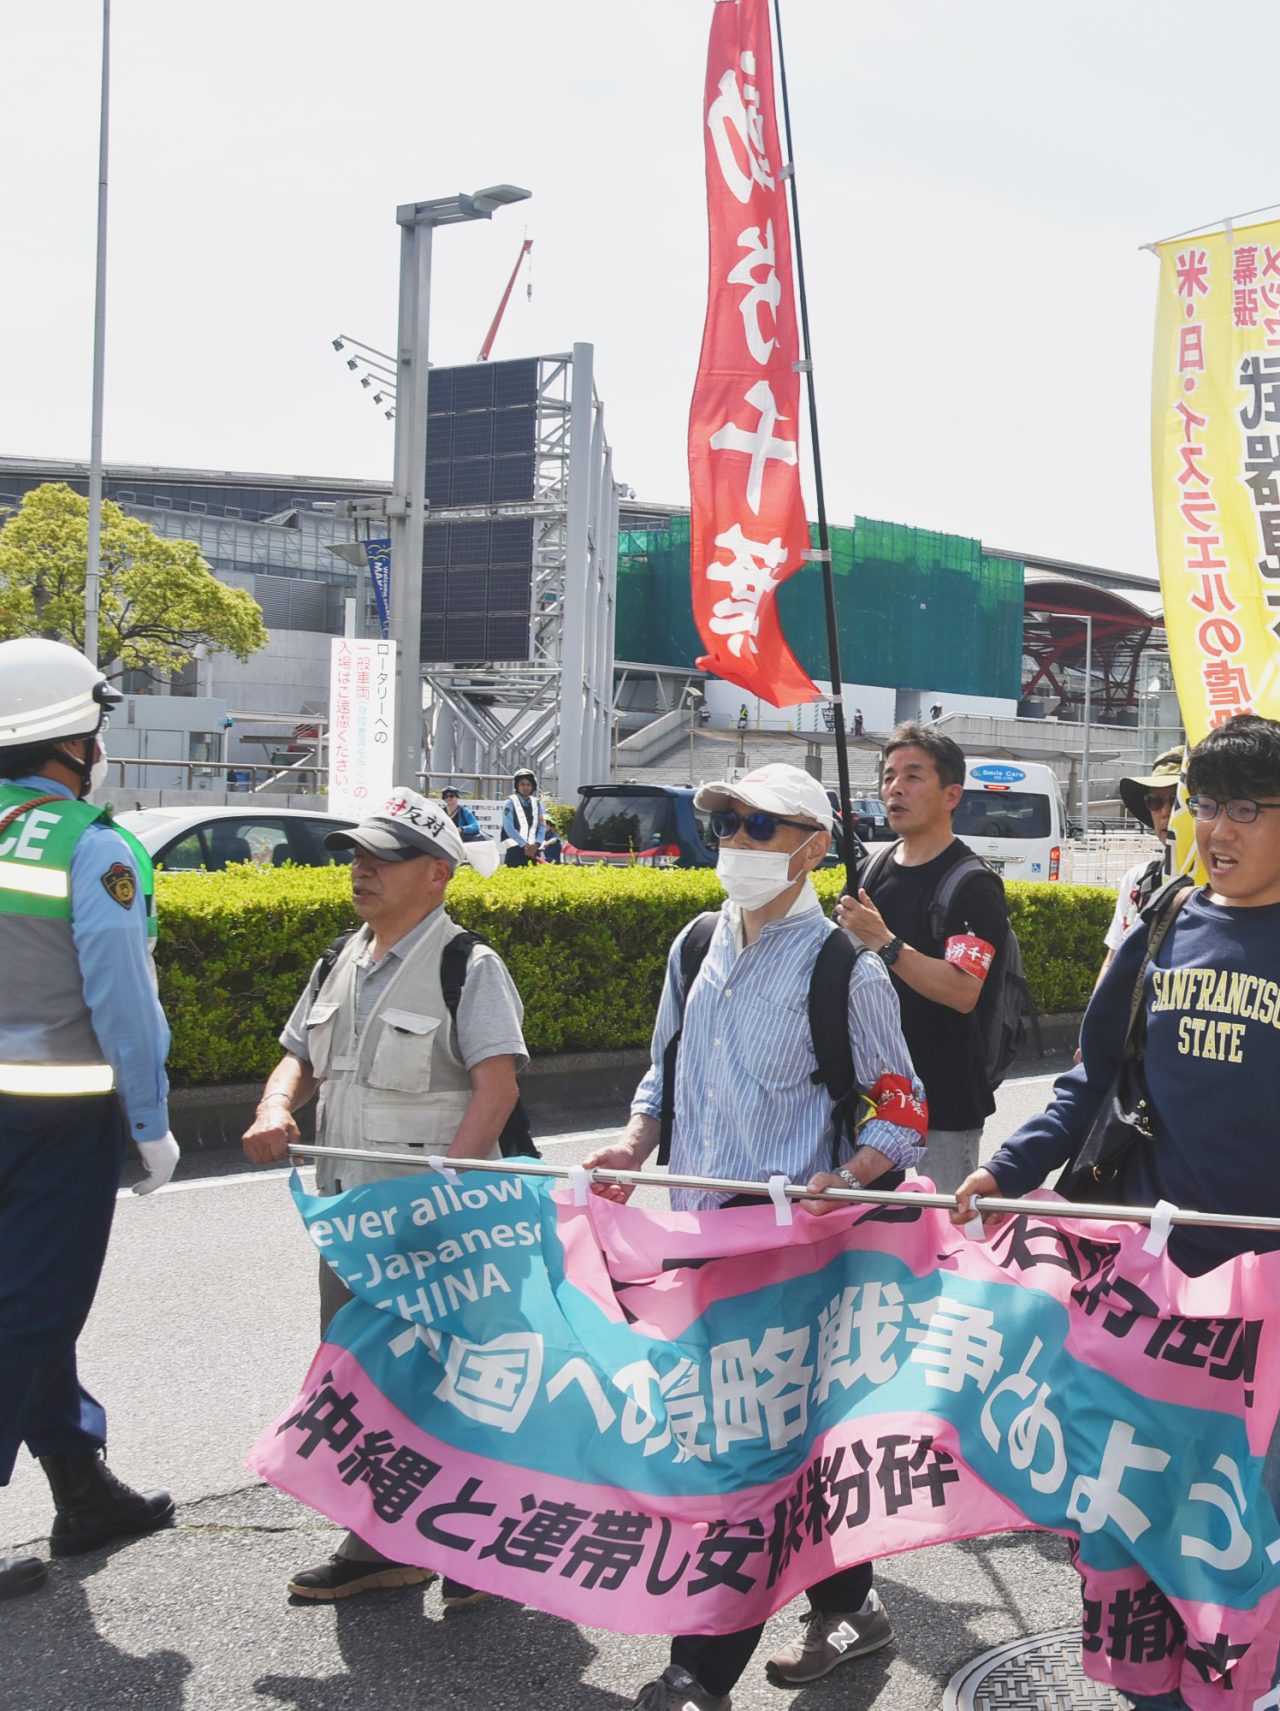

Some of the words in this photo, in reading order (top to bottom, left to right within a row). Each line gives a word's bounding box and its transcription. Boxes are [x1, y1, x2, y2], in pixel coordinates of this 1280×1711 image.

[375, 643, 389, 744] ロータリーへの
[1178, 1017, 1247, 1064] STATE
[410, 1178, 523, 1228] allow
[374, 1262, 512, 1324] HINA
[387, 1281, 1254, 1572] 国への侵略戦争とめよう
